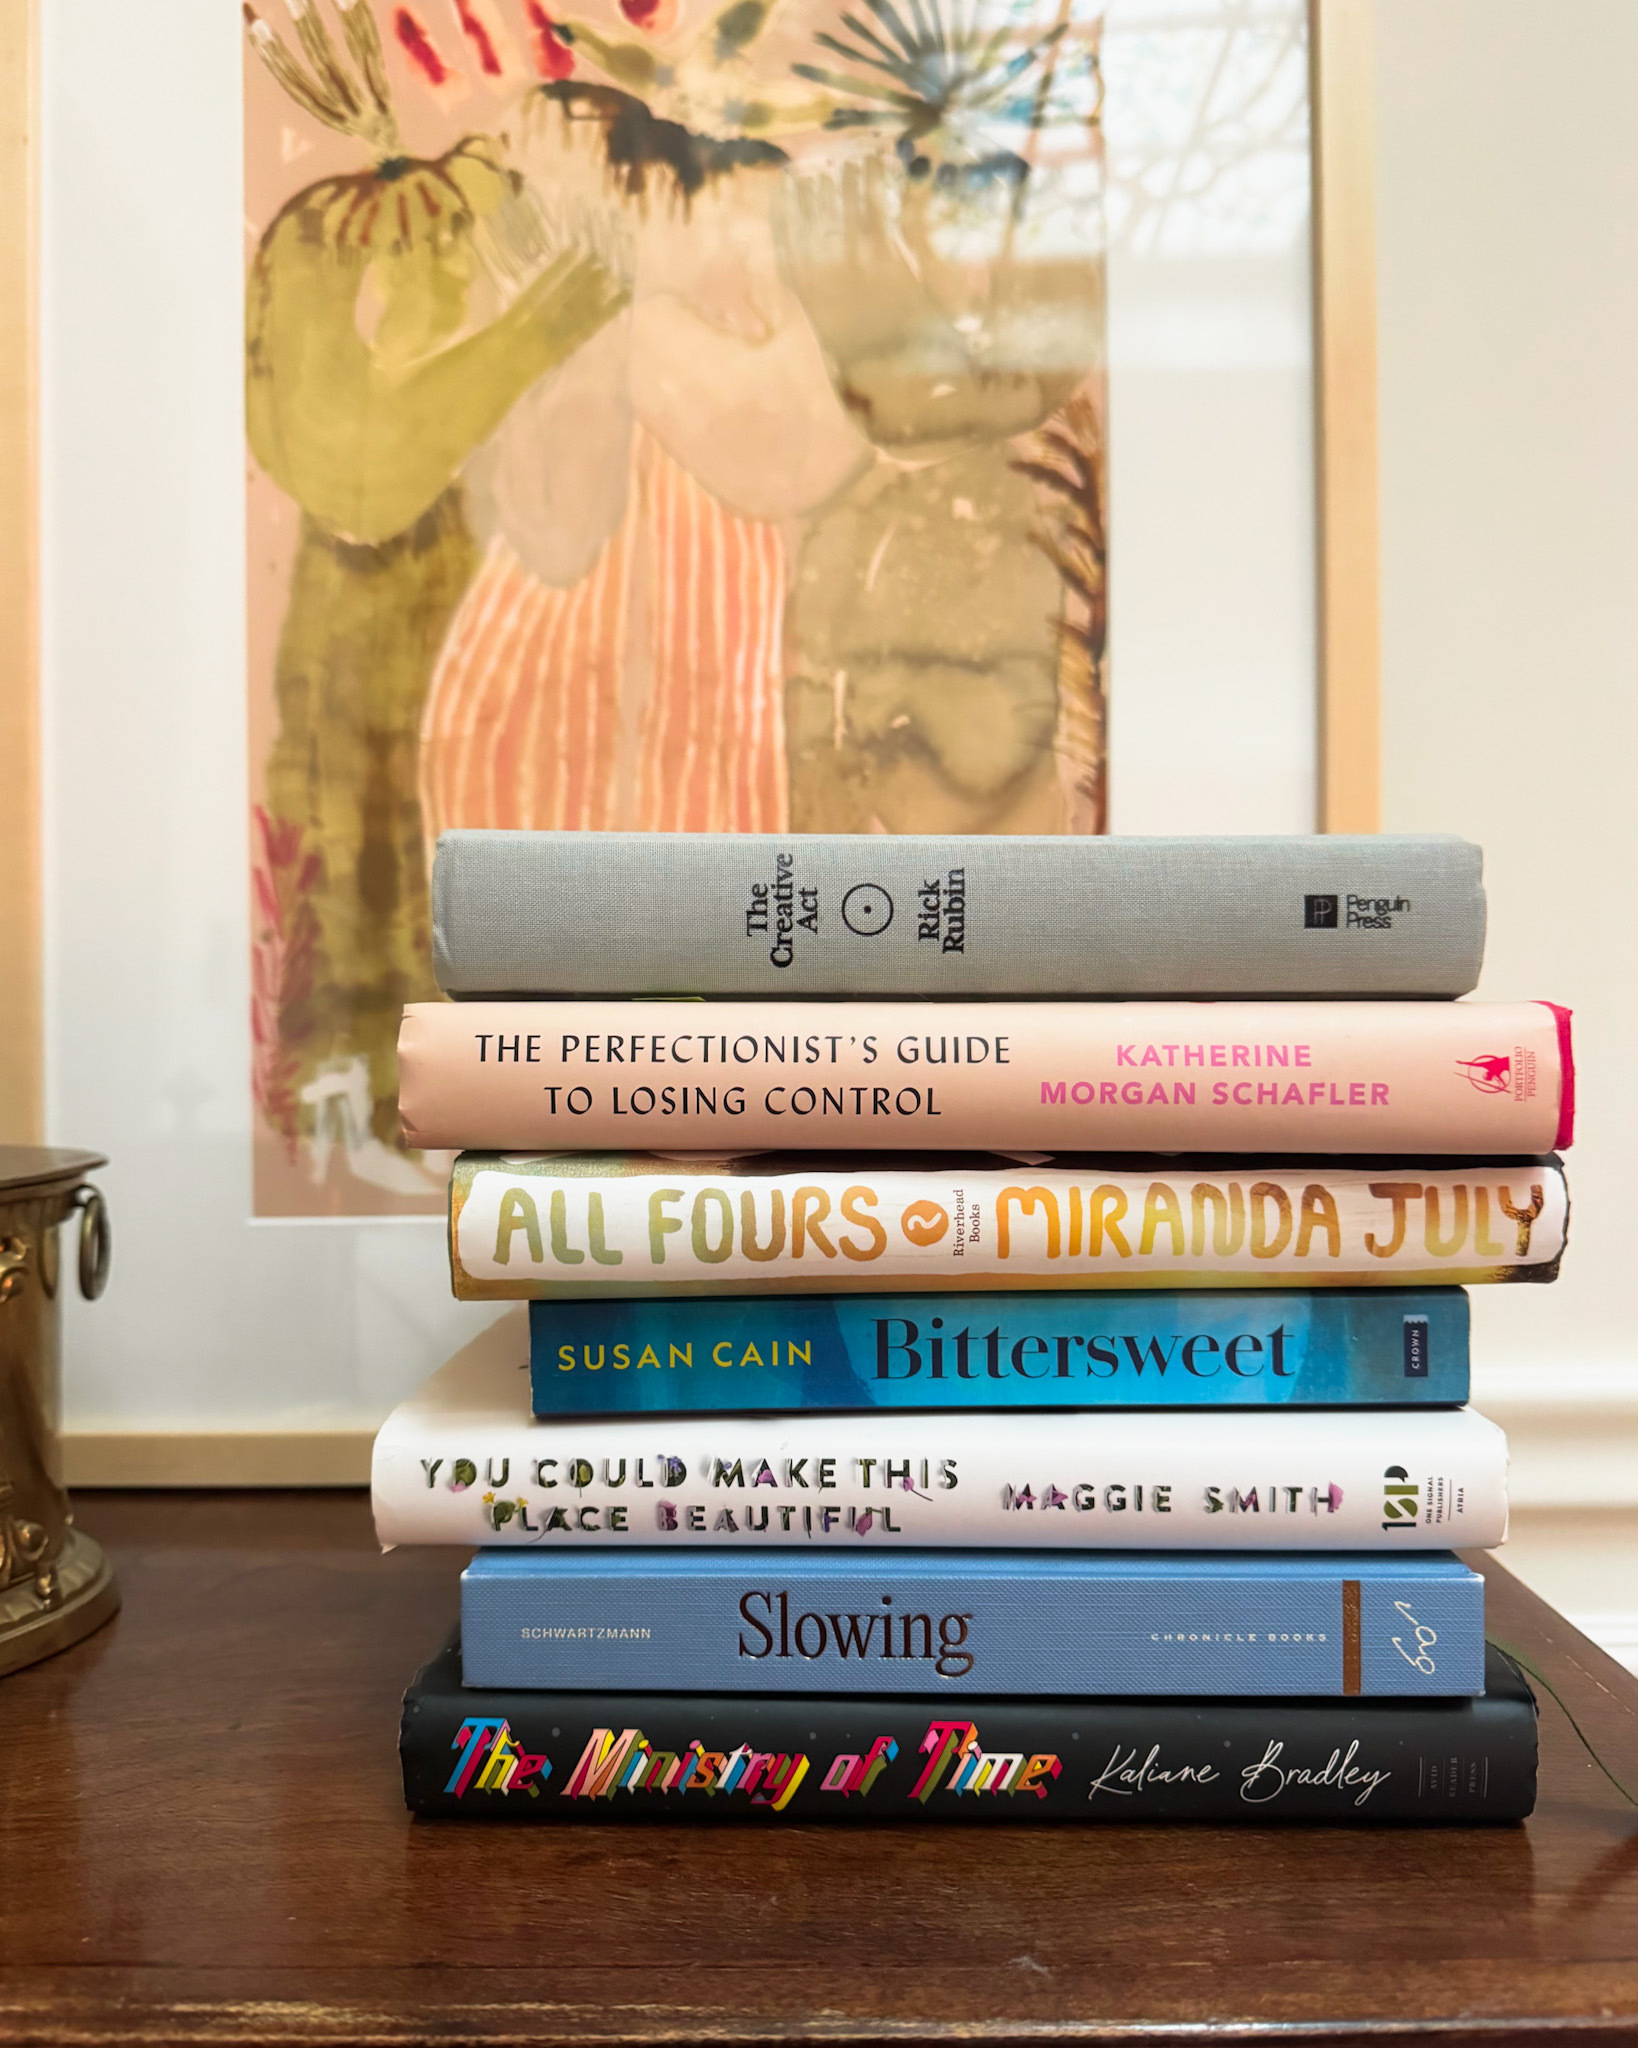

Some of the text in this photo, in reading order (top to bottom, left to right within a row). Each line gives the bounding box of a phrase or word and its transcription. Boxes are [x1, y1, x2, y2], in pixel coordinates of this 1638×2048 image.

[746, 883, 768, 937] The
[770, 853, 794, 968] Creative
[796, 887, 818, 935] Act
[918, 879, 940, 941] Rick
[942, 868, 965, 954] Rubin
[1346, 895, 1410, 916] Penguin
[1346, 911, 1392, 928] Press
[475, 1034, 541, 1063] THE
[896, 1035, 1010, 1064] GUIDE
[1116, 1044, 1312, 1067] KATHERINE
[1040, 1081, 1390, 1105] MORGAN SCHAFLER
[1514, 1046, 1523, 1102] PORTFOLIO
[1527, 1050, 1536, 1098] PENGUIN
[544, 1086, 942, 1115] TO LOSING CONTROL
[493, 1185, 888, 1266] ALL FOURS
[953, 1189, 964, 1257] Riverhead
[969, 1203, 981, 1243] Books
[996, 1181, 1543, 1259] MIRANDA JULY
[557, 1340, 812, 1371] SUSAN CAIN
[870, 1316, 1296, 1380] Bittersweet
[1411, 1329, 1420, 1369] CROWN
[420, 1455, 960, 1498] YOU COULD MAKE THIS
[1001, 1480, 1346, 1514] MAGGIE SMITH
[1425, 1476, 1434, 1525] ONE SIGNAL
[1436, 1476, 1444, 1524] PUBLISHERS
[1456, 1487, 1465, 1514] ATRIA
[491, 1498, 903, 1538] PLACE BEAUTIFUL
[520, 1626, 652, 1640] SCHWARTZMANN
[738, 1590, 974, 1678] Slowing
[1151, 1633, 1328, 1643] CHRONICLE BOOKS
[443, 1716, 1064, 1812] The Ministry of Time
[1088, 1739, 1392, 1807] Kaliane Bradley
